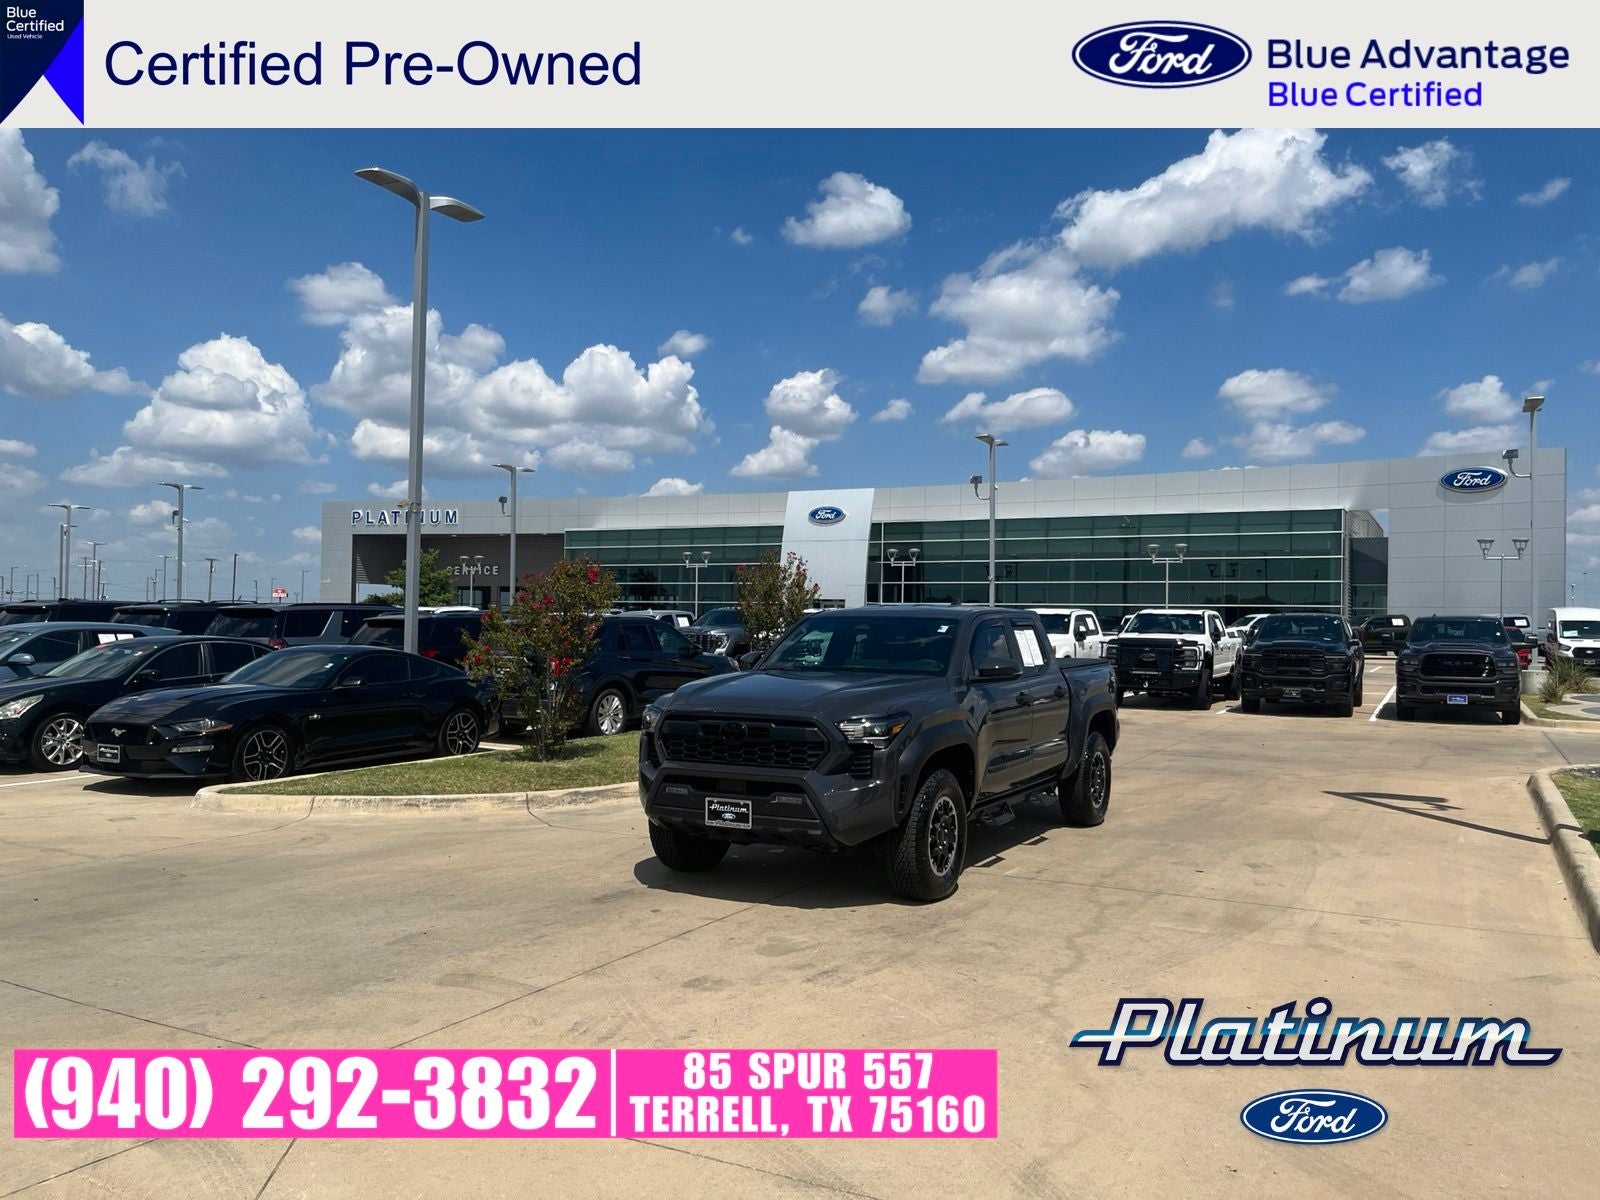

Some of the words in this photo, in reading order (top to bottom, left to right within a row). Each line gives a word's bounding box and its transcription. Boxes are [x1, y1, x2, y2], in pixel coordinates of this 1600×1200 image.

[1453, 471, 1492, 487] Ford
[815, 509, 837, 519] Ford
[709, 804, 747, 813] Platinum
